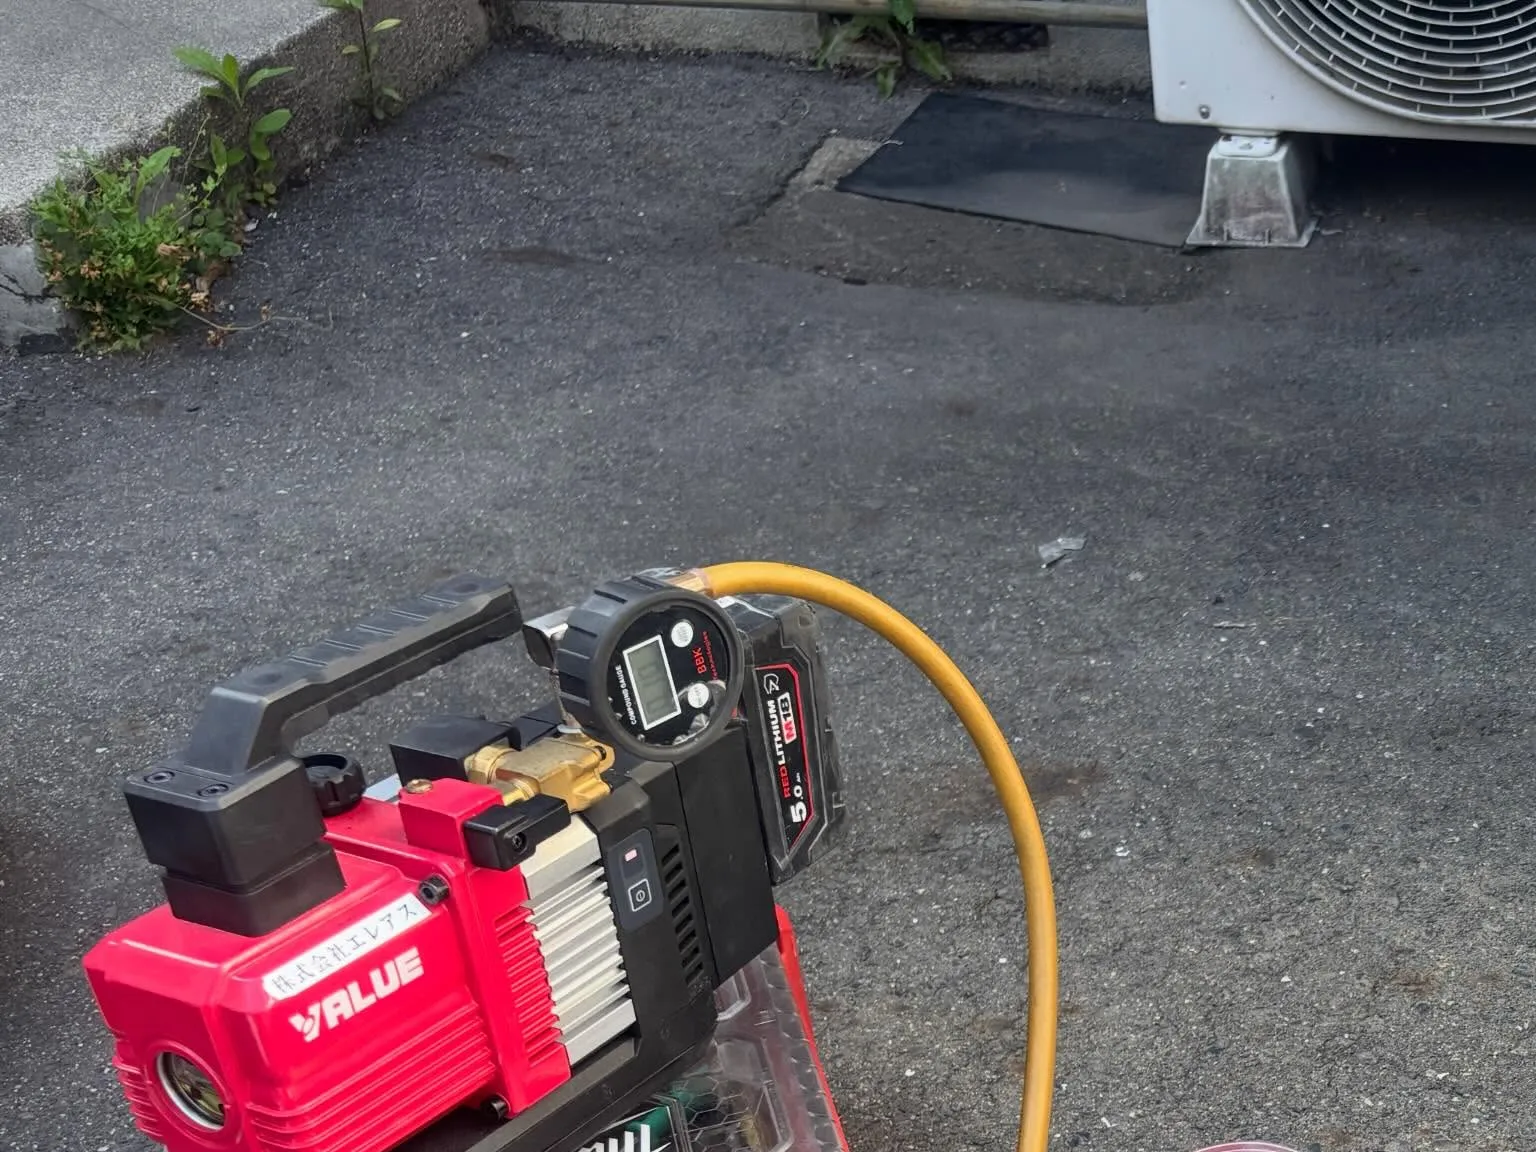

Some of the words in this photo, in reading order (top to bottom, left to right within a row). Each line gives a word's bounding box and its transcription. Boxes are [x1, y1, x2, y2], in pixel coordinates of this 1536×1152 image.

[614, 663, 627, 689] GAUGE
[692, 647, 707, 675] BBK
[621, 688, 638, 726] COMPOUND
[778, 694, 796, 744] M18
[790, 783, 807, 823] 5.0
[271, 902, 418, 994] 株式会社エレアス
[288, 945, 425, 1043] VALUE
